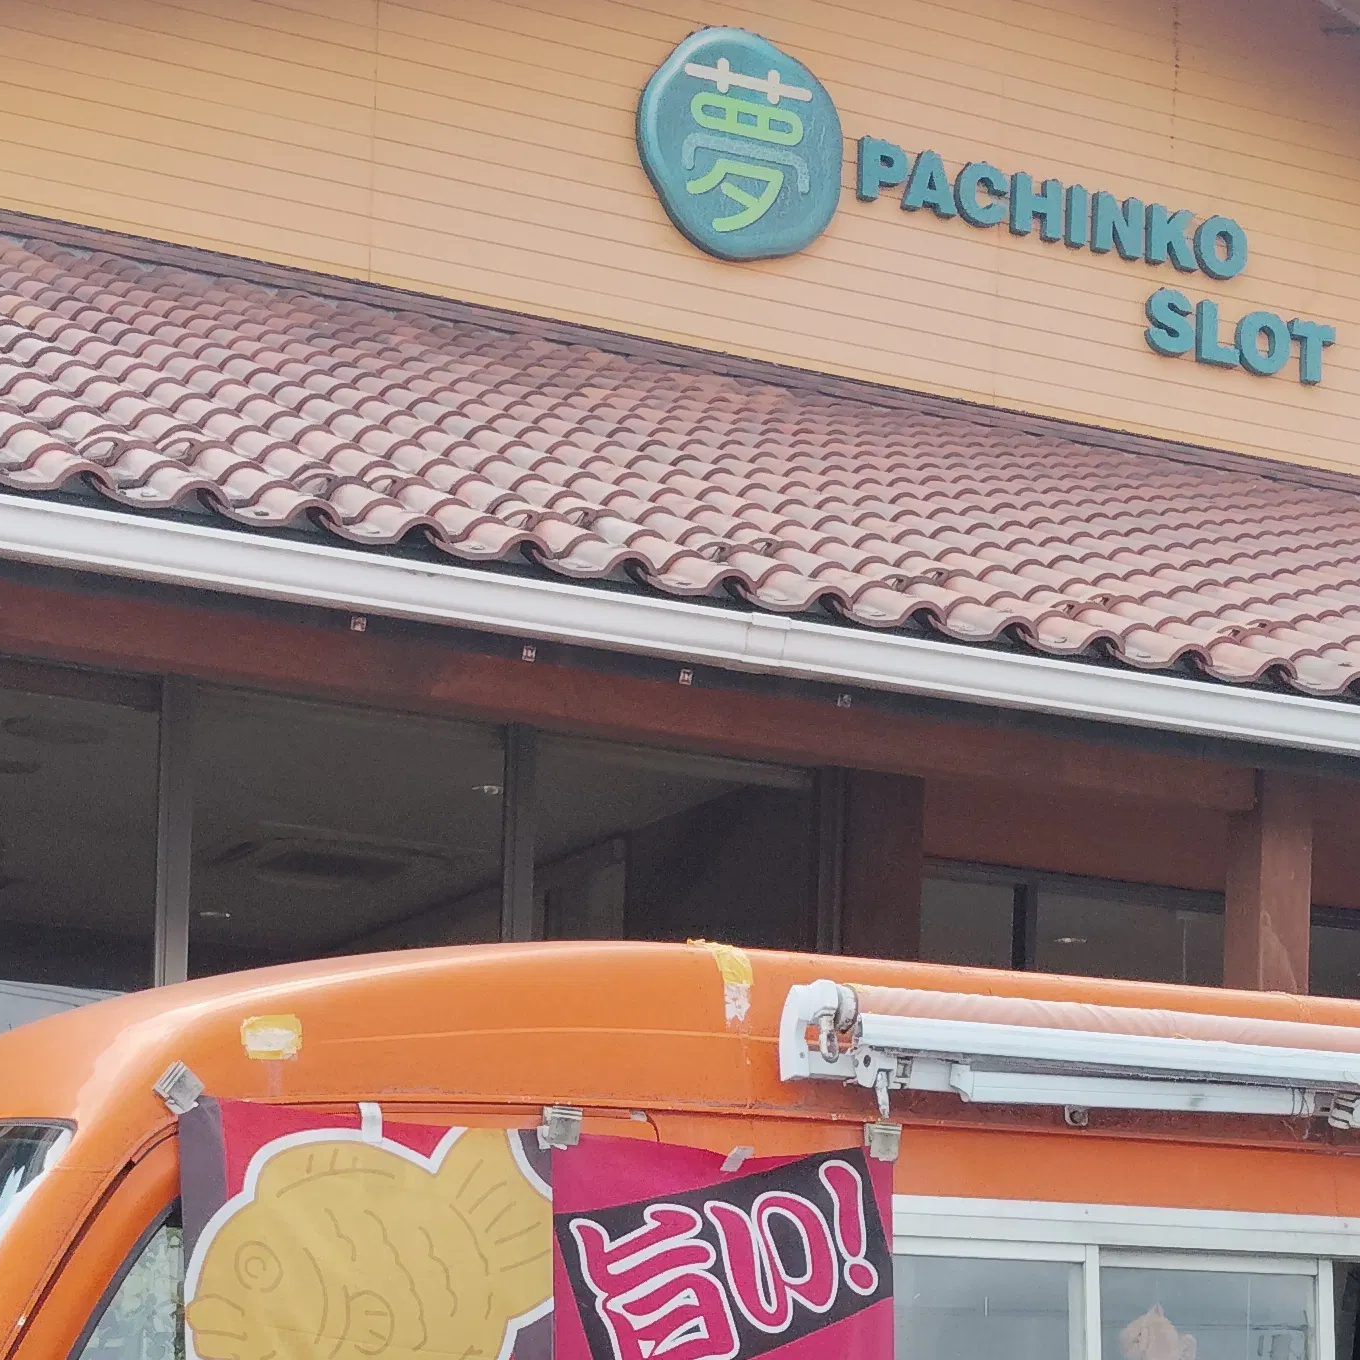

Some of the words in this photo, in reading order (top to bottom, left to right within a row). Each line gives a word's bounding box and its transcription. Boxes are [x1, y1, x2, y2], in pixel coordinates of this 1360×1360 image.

[683, 57, 813, 232] 夢
[857, 134, 1248, 281] PACHINKO
[1144, 286, 1336, 386] SLOT
